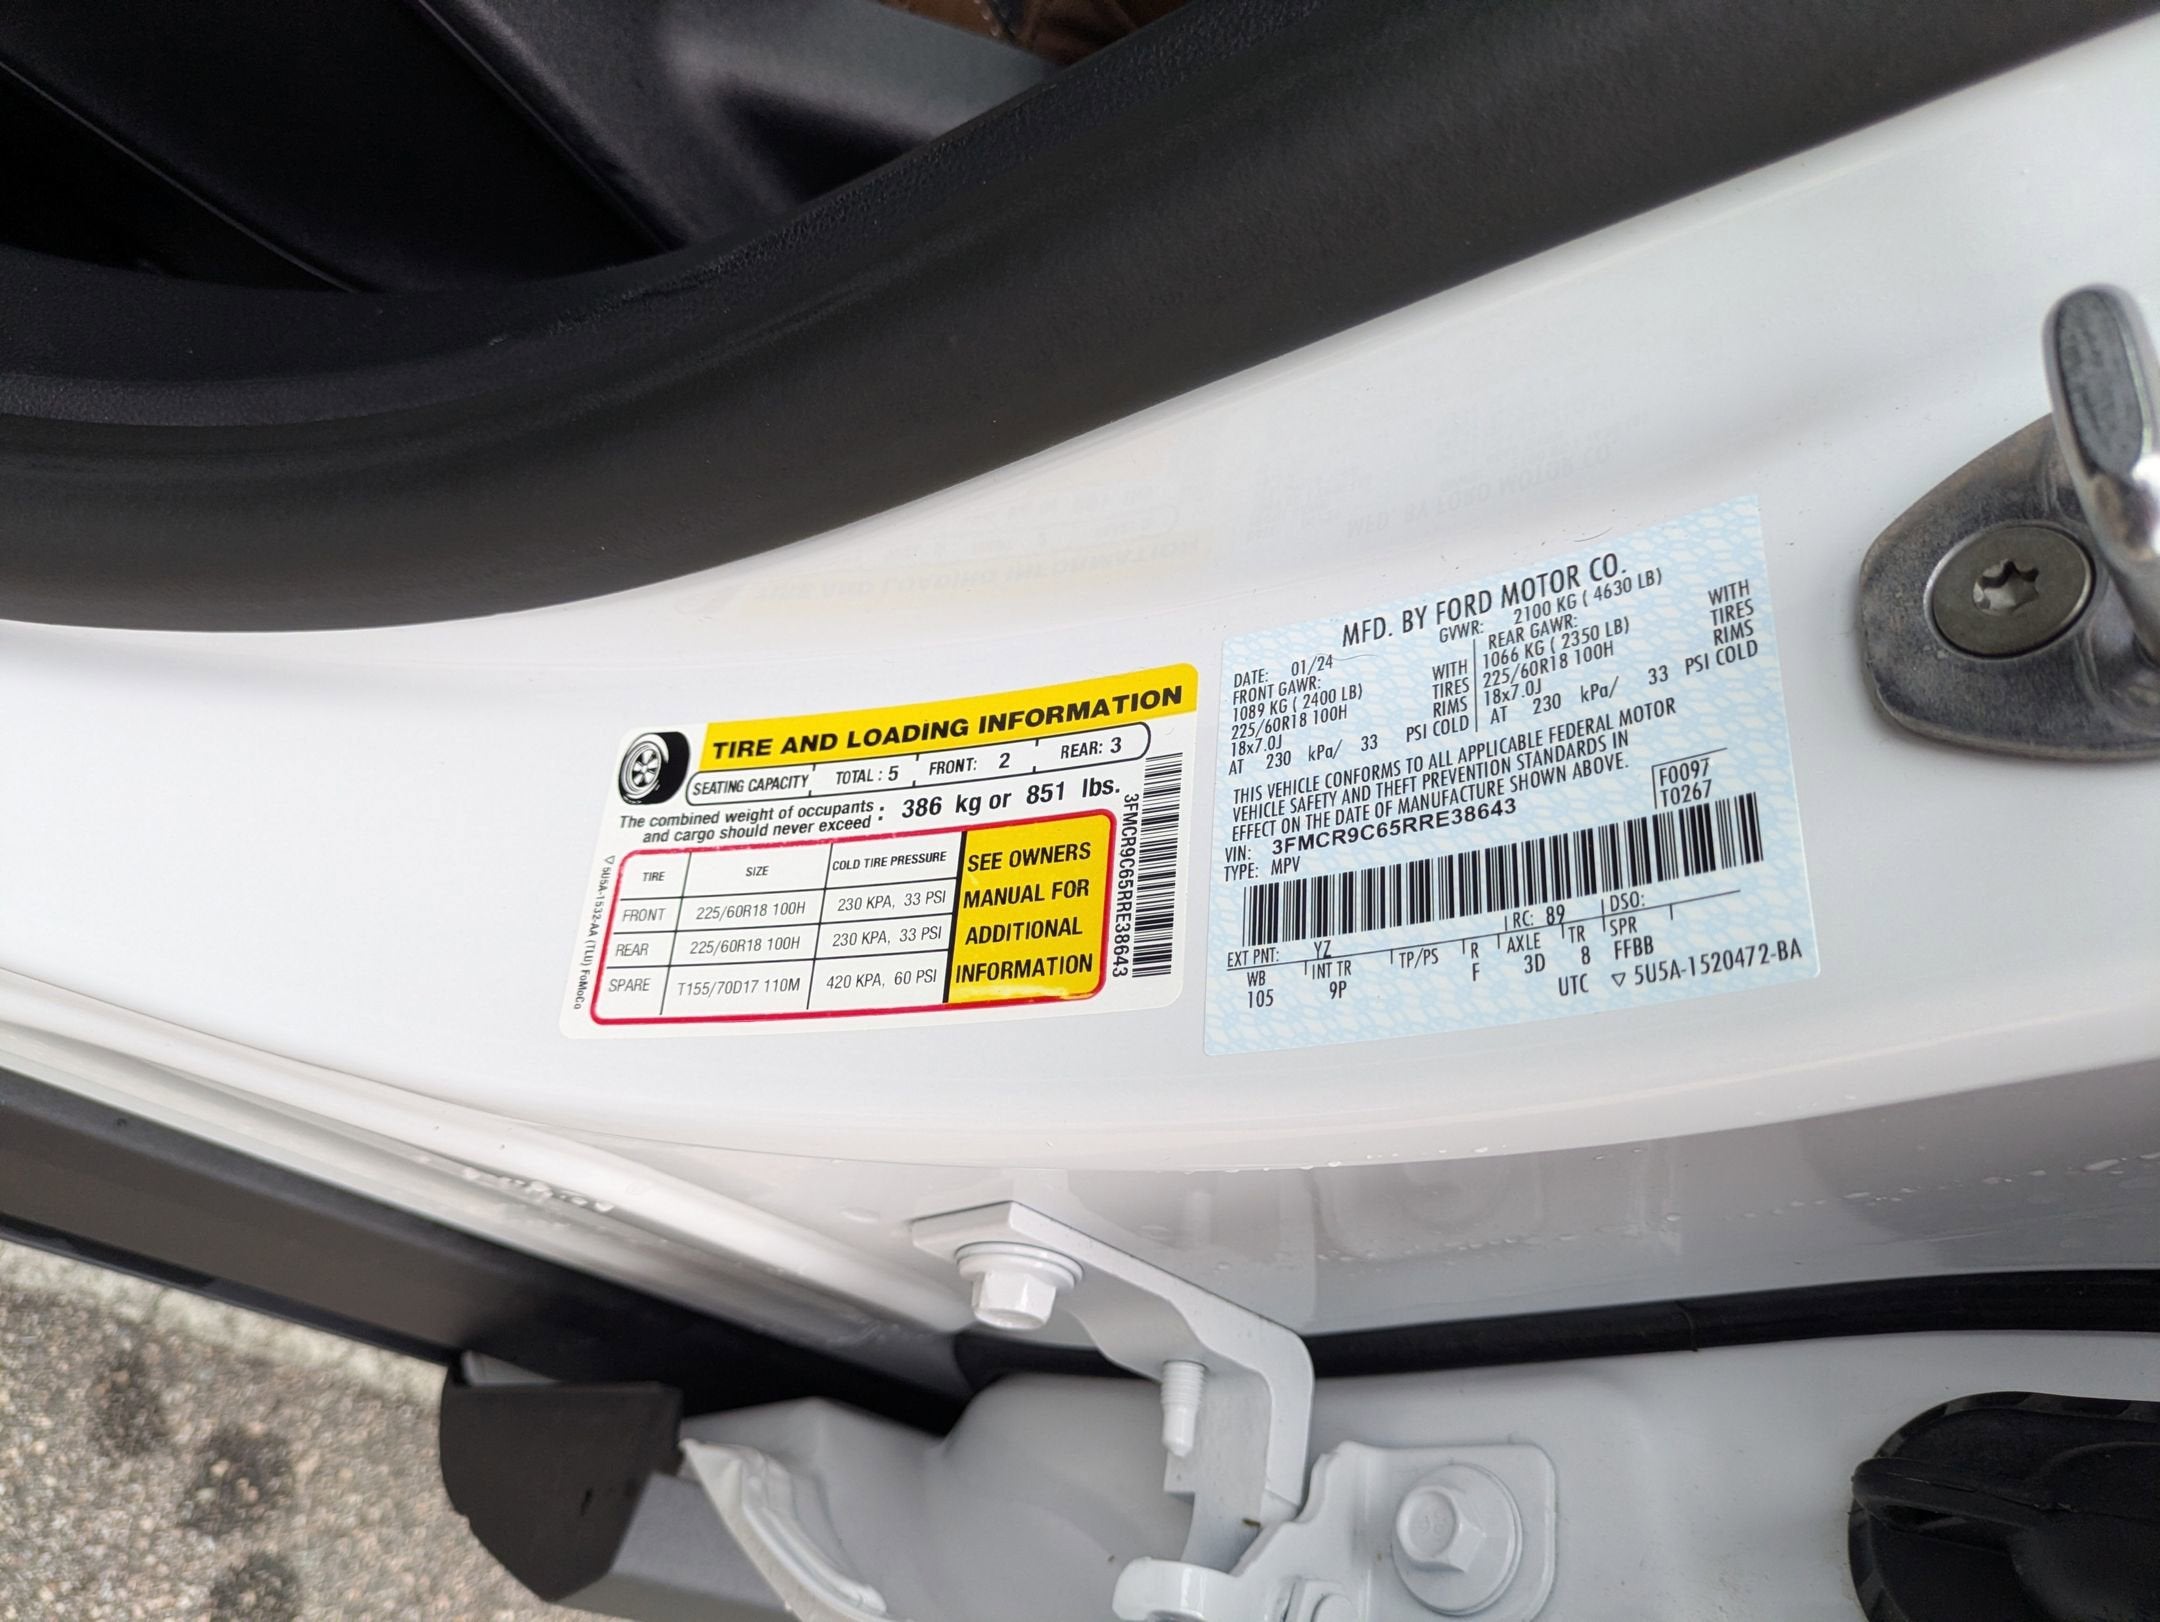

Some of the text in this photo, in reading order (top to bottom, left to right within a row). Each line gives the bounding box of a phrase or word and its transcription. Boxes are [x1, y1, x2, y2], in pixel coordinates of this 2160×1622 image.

[1342, 553, 1627, 647] MFD. BY FORD MOTOR CO.
[1439, 567, 1662, 644] GVWR: 2100 KG 4630 LB)
[1483, 616, 1629, 669] 1066 KG 2350 LB)
[1488, 614, 1578, 650] REAR GAWR:
[1234, 654, 1333, 688] DATE: 01/24
[1483, 641, 1614, 689] 225/60R18 100H
[1233, 677, 1322, 705] FRONT GAWR:
[1484, 678, 1541, 706] 18x7.0J
[1490, 639, 1759, 725] AT 230 kPa/ 33 PSI COLD
[1232, 683, 1363, 723] 1089 KG 2400 LB)
[713, 686, 1182, 759] TIRE AND LOADING INFORMATION
[1231, 705, 1348, 740] 225/60R18 100H
[1061, 737, 1122, 759] REAR: 3
[1229, 715, 1469, 775] AT 230 kPa/ 33 PSI COLD
[1231, 734, 1282, 757] 18x7.0J
[1233, 698, 1676, 804] THIS VEHICLE CONFORMS TO ALL APPLICABLE FEDERAL MOTOR
[836, 766, 899, 785] TOTAL 5
[929, 753, 1010, 775] FRONT: 2
[1233, 730, 1629, 823] VEHICLE SAFETY AND THEFT PREVENTION STANDARDS IN
[693, 774, 809, 796] SEATING CAPACITY
[902, 778, 1120, 818] 386 kg or 851 lbs.
[1232, 753, 1629, 842] EFFECT ON THE DATE OF MANUFACTURE SHOWN ABOVE.
[620, 800, 874, 828] The combined weight of occupants
[643, 817, 871, 845] and cargo should never exceed
[1225, 798, 1517, 863] VIN: 3FMCR9C65RRE38643
[642, 851, 946, 882] TIRE SIZE COLD TIRE PRESSURE
[968, 842, 1091, 872] SEE OWNERS
[1224, 856, 1301, 882] TYPE: MPV
[963, 879, 1089, 909] MANUAL FOR
[1112, 793, 1139, 978] 3FMCR9C65RRE38643
[622, 891, 946, 922] FRONT 225/60R18 100H 230 KPA, 33 PSI
[1610, 891, 1645, 912] DSO:
[965, 917, 1083, 945] ADDITIONAL
[1513, 904, 1565, 929] RC: 89
[1610, 917, 1638, 937] SPR
[615, 926, 942, 956] REAR 225/60R18 100H 230 KPA, 33 PSI
[1507, 932, 1541, 953] AXLE
[1568, 926, 1586, 944] TR
[1614, 936, 1654, 960] FFBB
[581, 939, 596, 966] (TLU)
[1228, 940, 1332, 968] EXT PNT: YZ
[1399, 948, 1439, 969] TP/PS
[1558, 937, 1802, 996] UTC 5U5A-1520472-BA
[608, 969, 937, 997] SPARE T155/70D17 110M 420 KPA, 60 PSI
[956, 953, 1093, 984] INFORMATION
[1247, 971, 1266, 987] WB
[1312, 960, 1352, 980] INT TR
[573, 969, 590, 1010] FoMoCo
[1247, 989, 1274, 1008] 105
[1329, 981, 1347, 999] 9P
